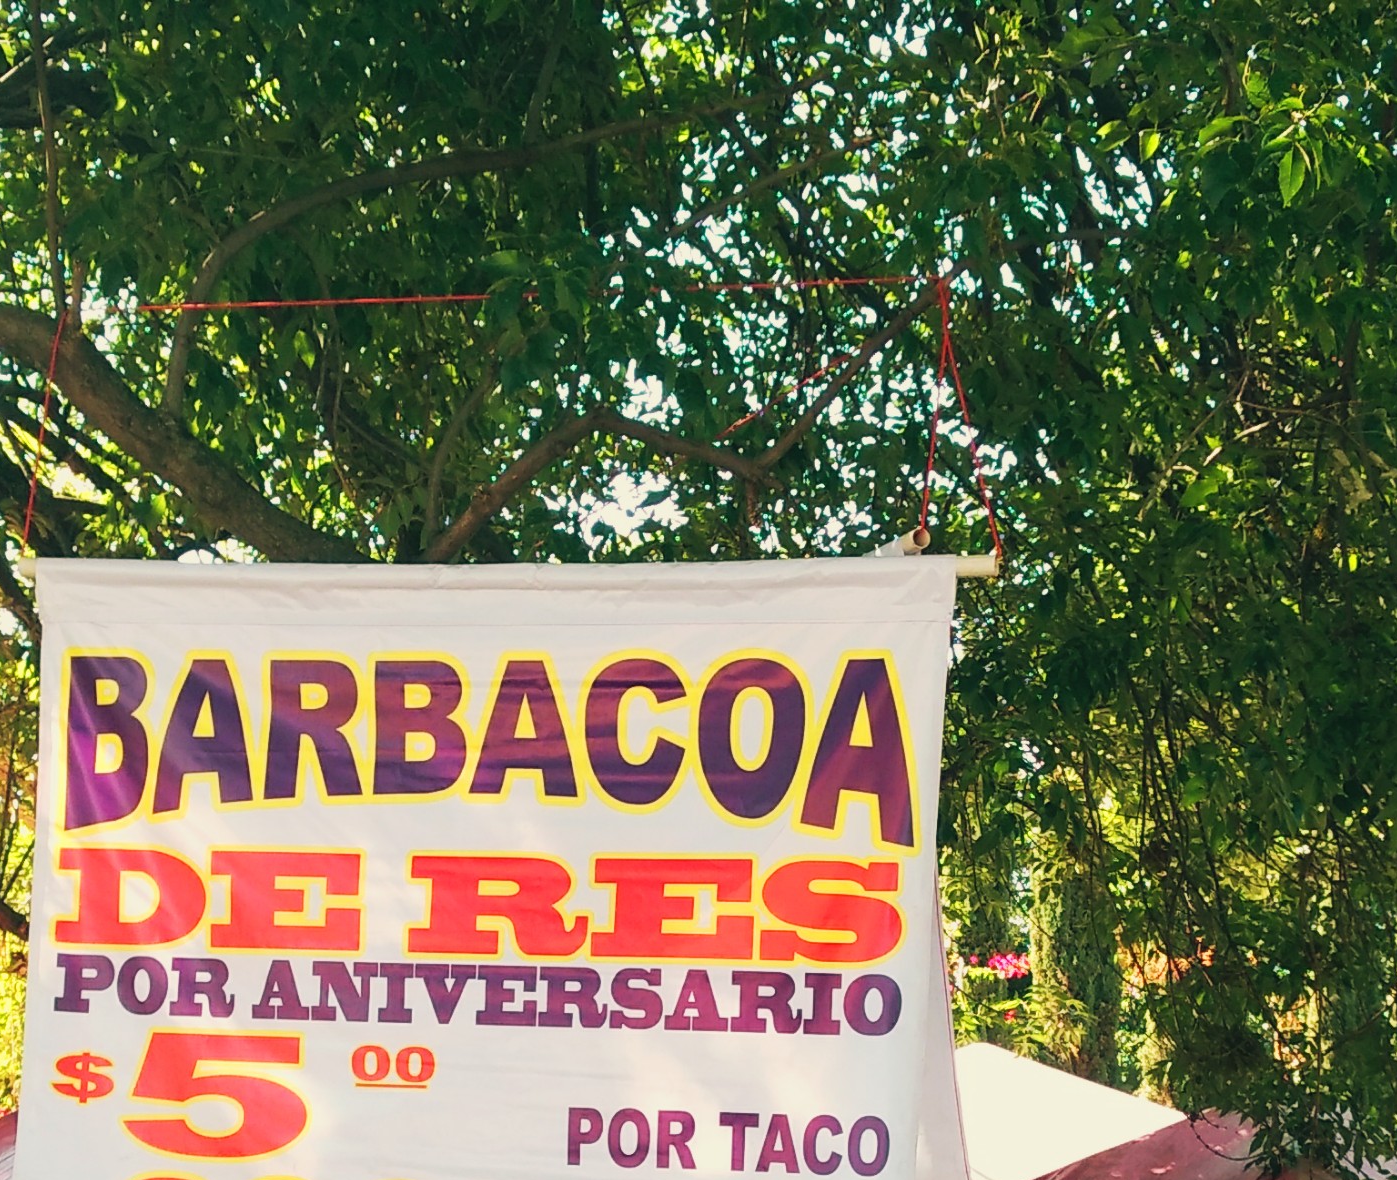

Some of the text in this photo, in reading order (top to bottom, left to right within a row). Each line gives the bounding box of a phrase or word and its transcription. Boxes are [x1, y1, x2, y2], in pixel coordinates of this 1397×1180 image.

[62, 649, 918, 852] BARBACOA
[52, 846, 905, 962] DE RES
[53, 954, 902, 1036] POR ANIVERSARIO
[567, 1107, 696, 1171] POR
[719, 1112, 890, 1176] TACO
